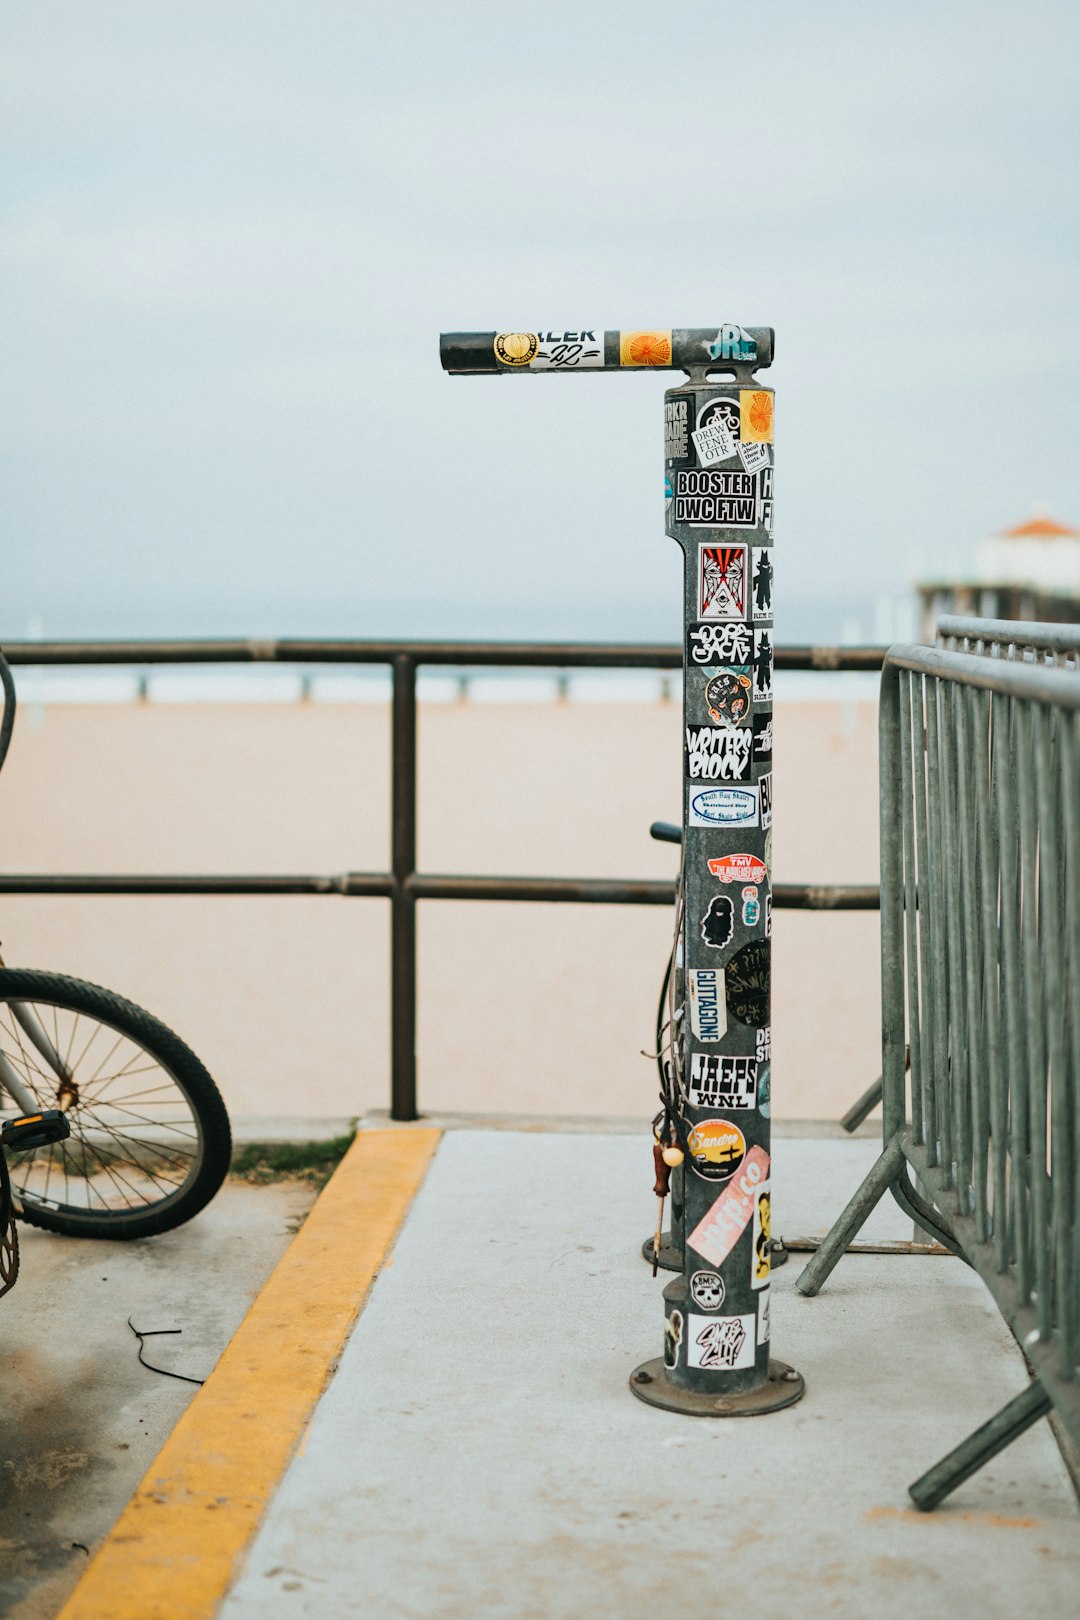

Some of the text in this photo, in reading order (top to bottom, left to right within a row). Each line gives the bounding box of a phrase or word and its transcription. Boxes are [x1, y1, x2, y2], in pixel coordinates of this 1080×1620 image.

[695, 424, 726, 442] DREW
[699, 433, 729, 452] FENE
[705, 445, 729, 460] OTR
[677, 471, 752, 496] BOOSTER
[675, 497, 754, 521] DWC FTW
[686, 727, 752, 755] WRITERS
[689, 751, 748, 780] BLOCK
[697, 971, 719, 1040] GUTTAGONE
[698, 1277, 716, 1286] BMX
